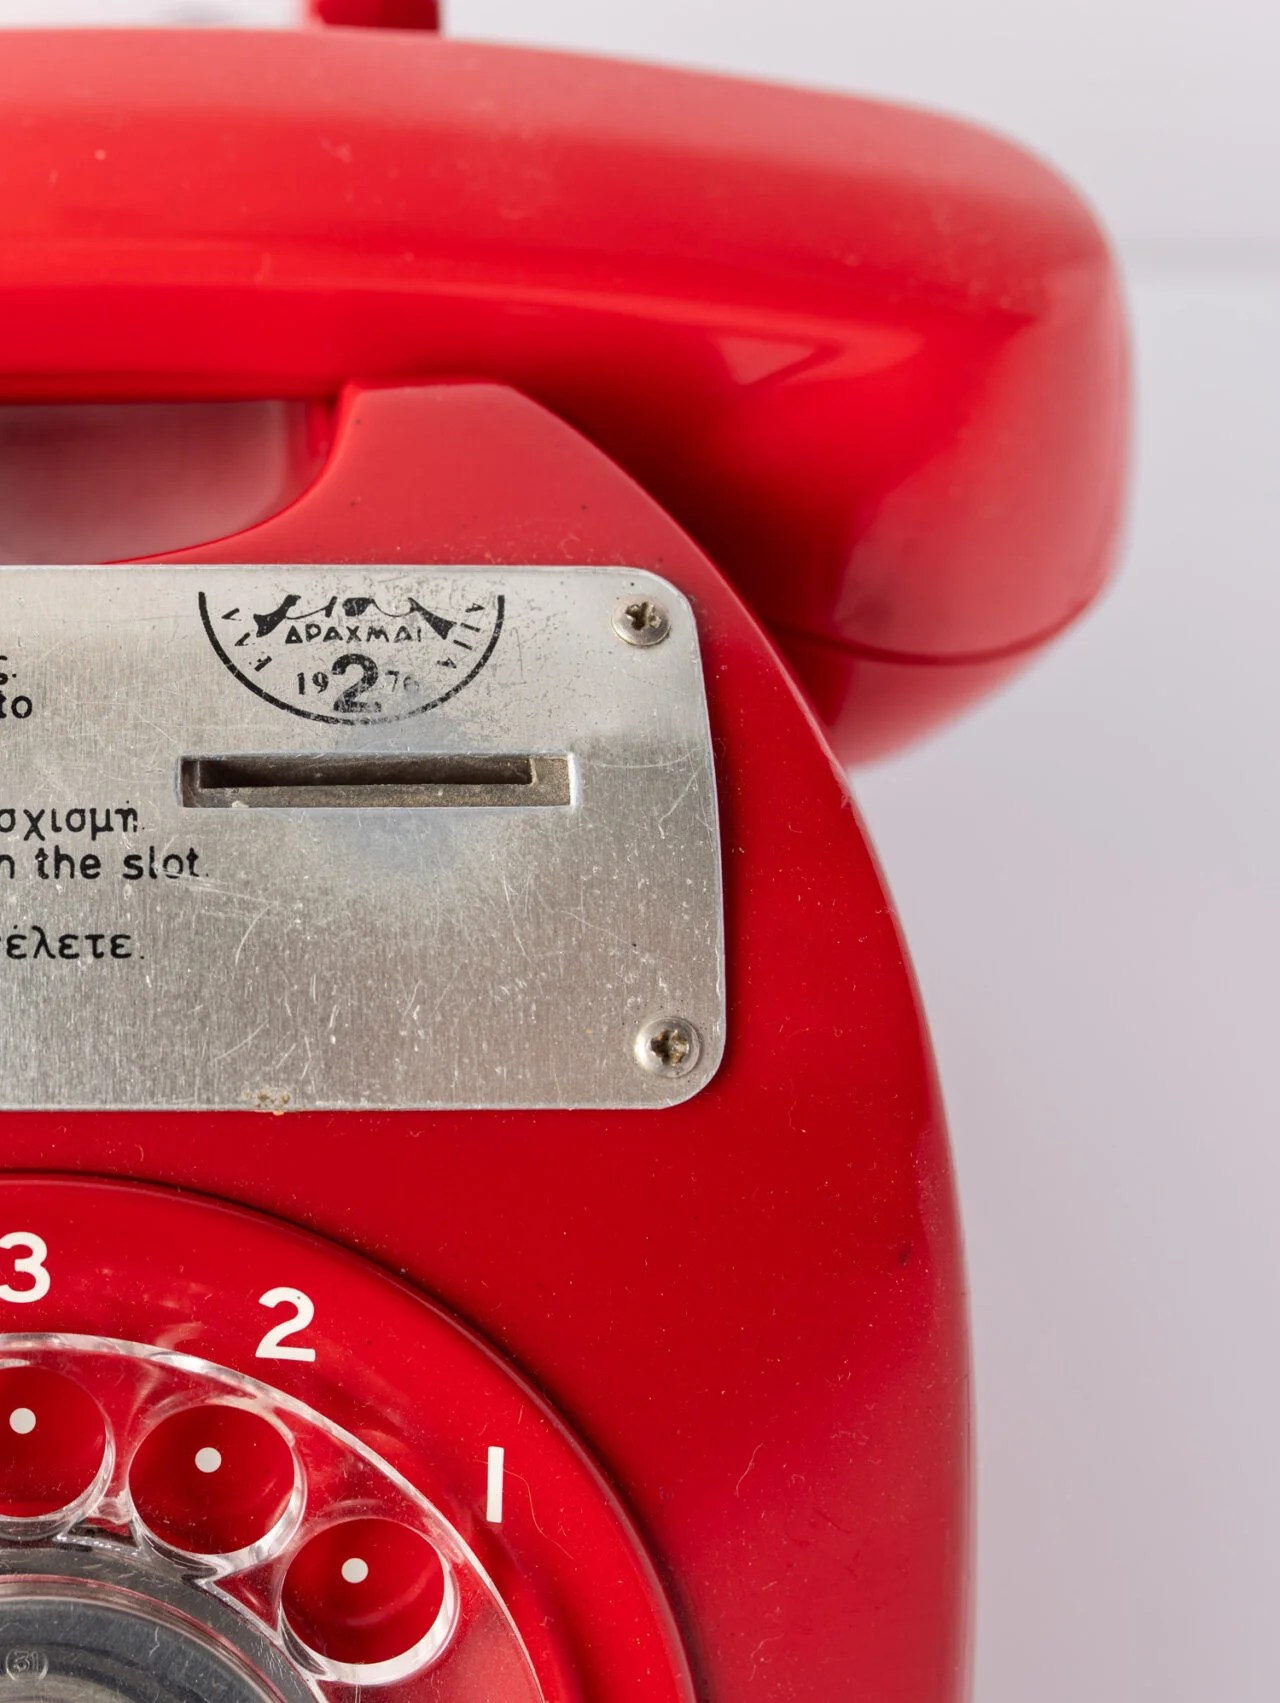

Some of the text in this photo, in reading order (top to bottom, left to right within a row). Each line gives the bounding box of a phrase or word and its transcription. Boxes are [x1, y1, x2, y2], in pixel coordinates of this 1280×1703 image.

[35, 845, 102, 880] the
[122, 846, 210, 880] slot.
[256, 1287, 315, 1361] 2
[487, 1447, 504, 1523] 1
